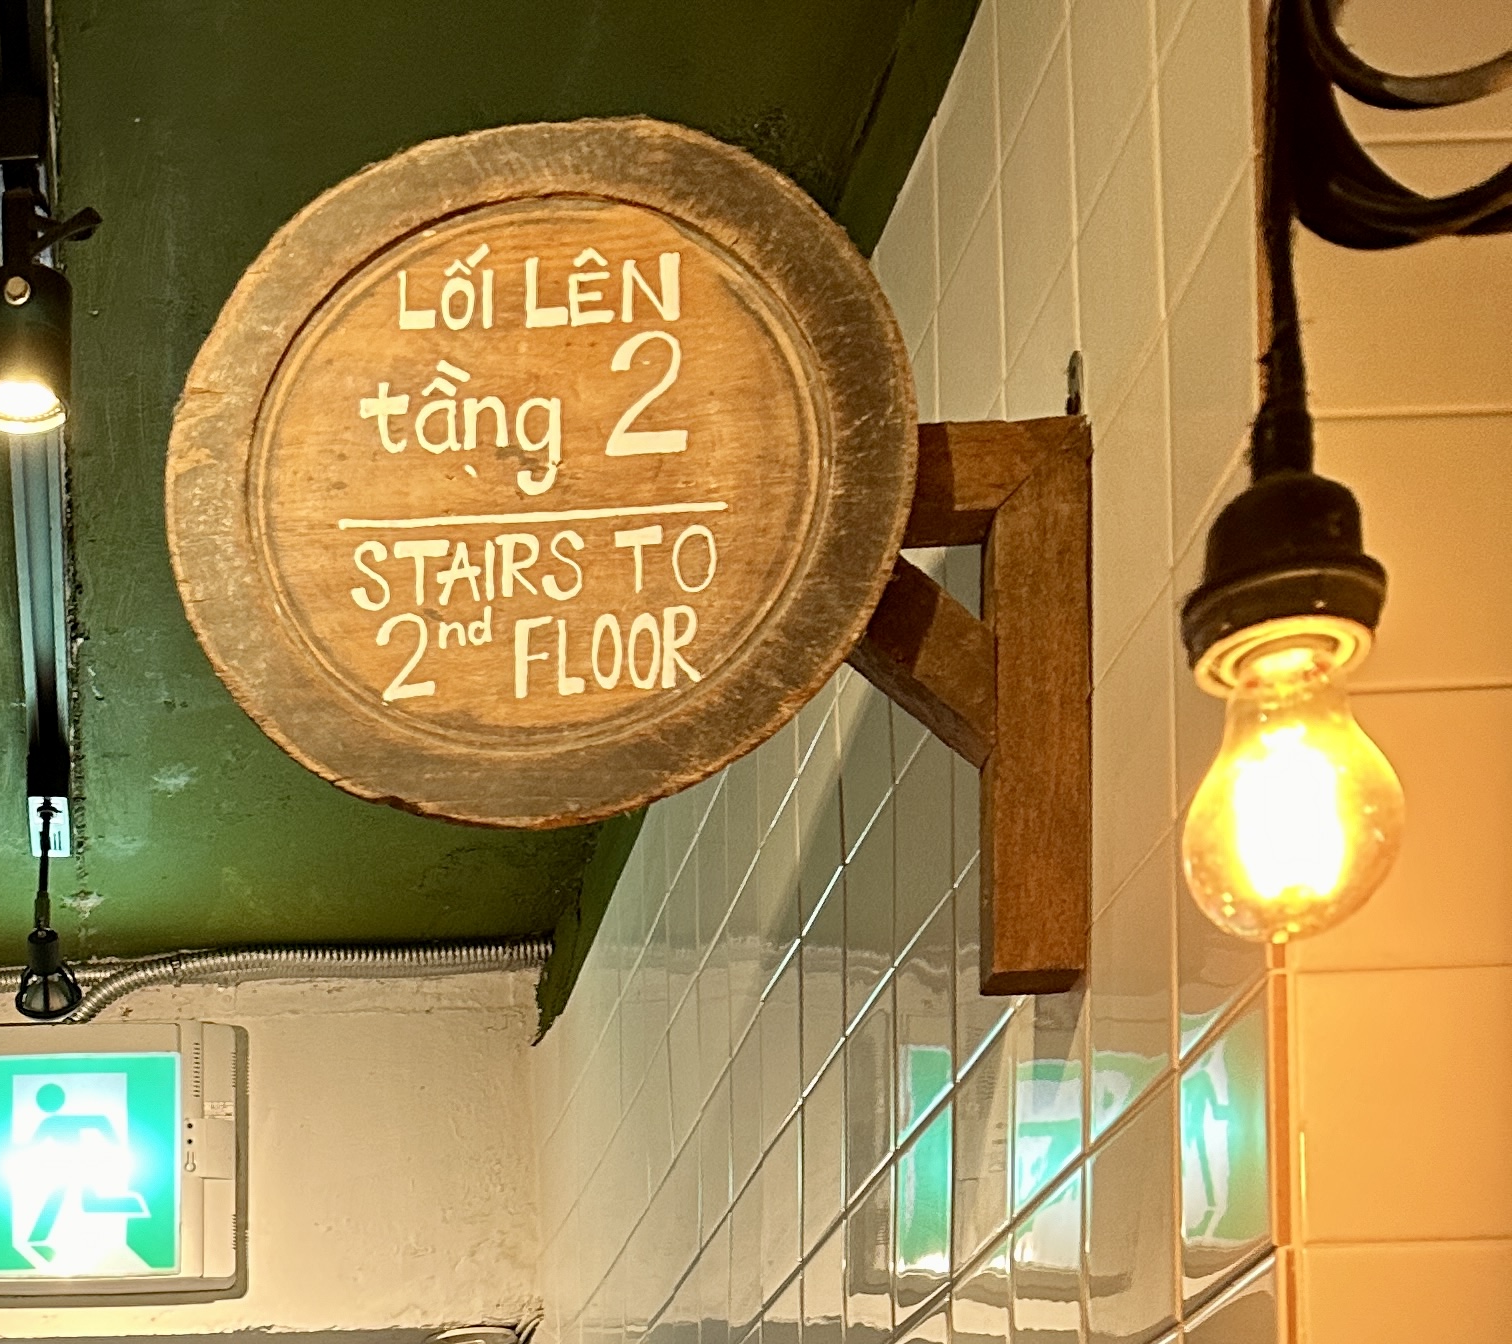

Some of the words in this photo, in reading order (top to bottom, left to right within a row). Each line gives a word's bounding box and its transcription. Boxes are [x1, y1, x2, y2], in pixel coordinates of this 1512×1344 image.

[524, 250, 680, 328] LÊN
[360, 360, 561, 496] tầng
[605, 330, 687, 456] 2
[350, 530, 585, 611] STAIRS
[615, 525, 717, 592] TO
[377, 607, 493, 705] 2nd
[515, 605, 702, 698] FLOOR
